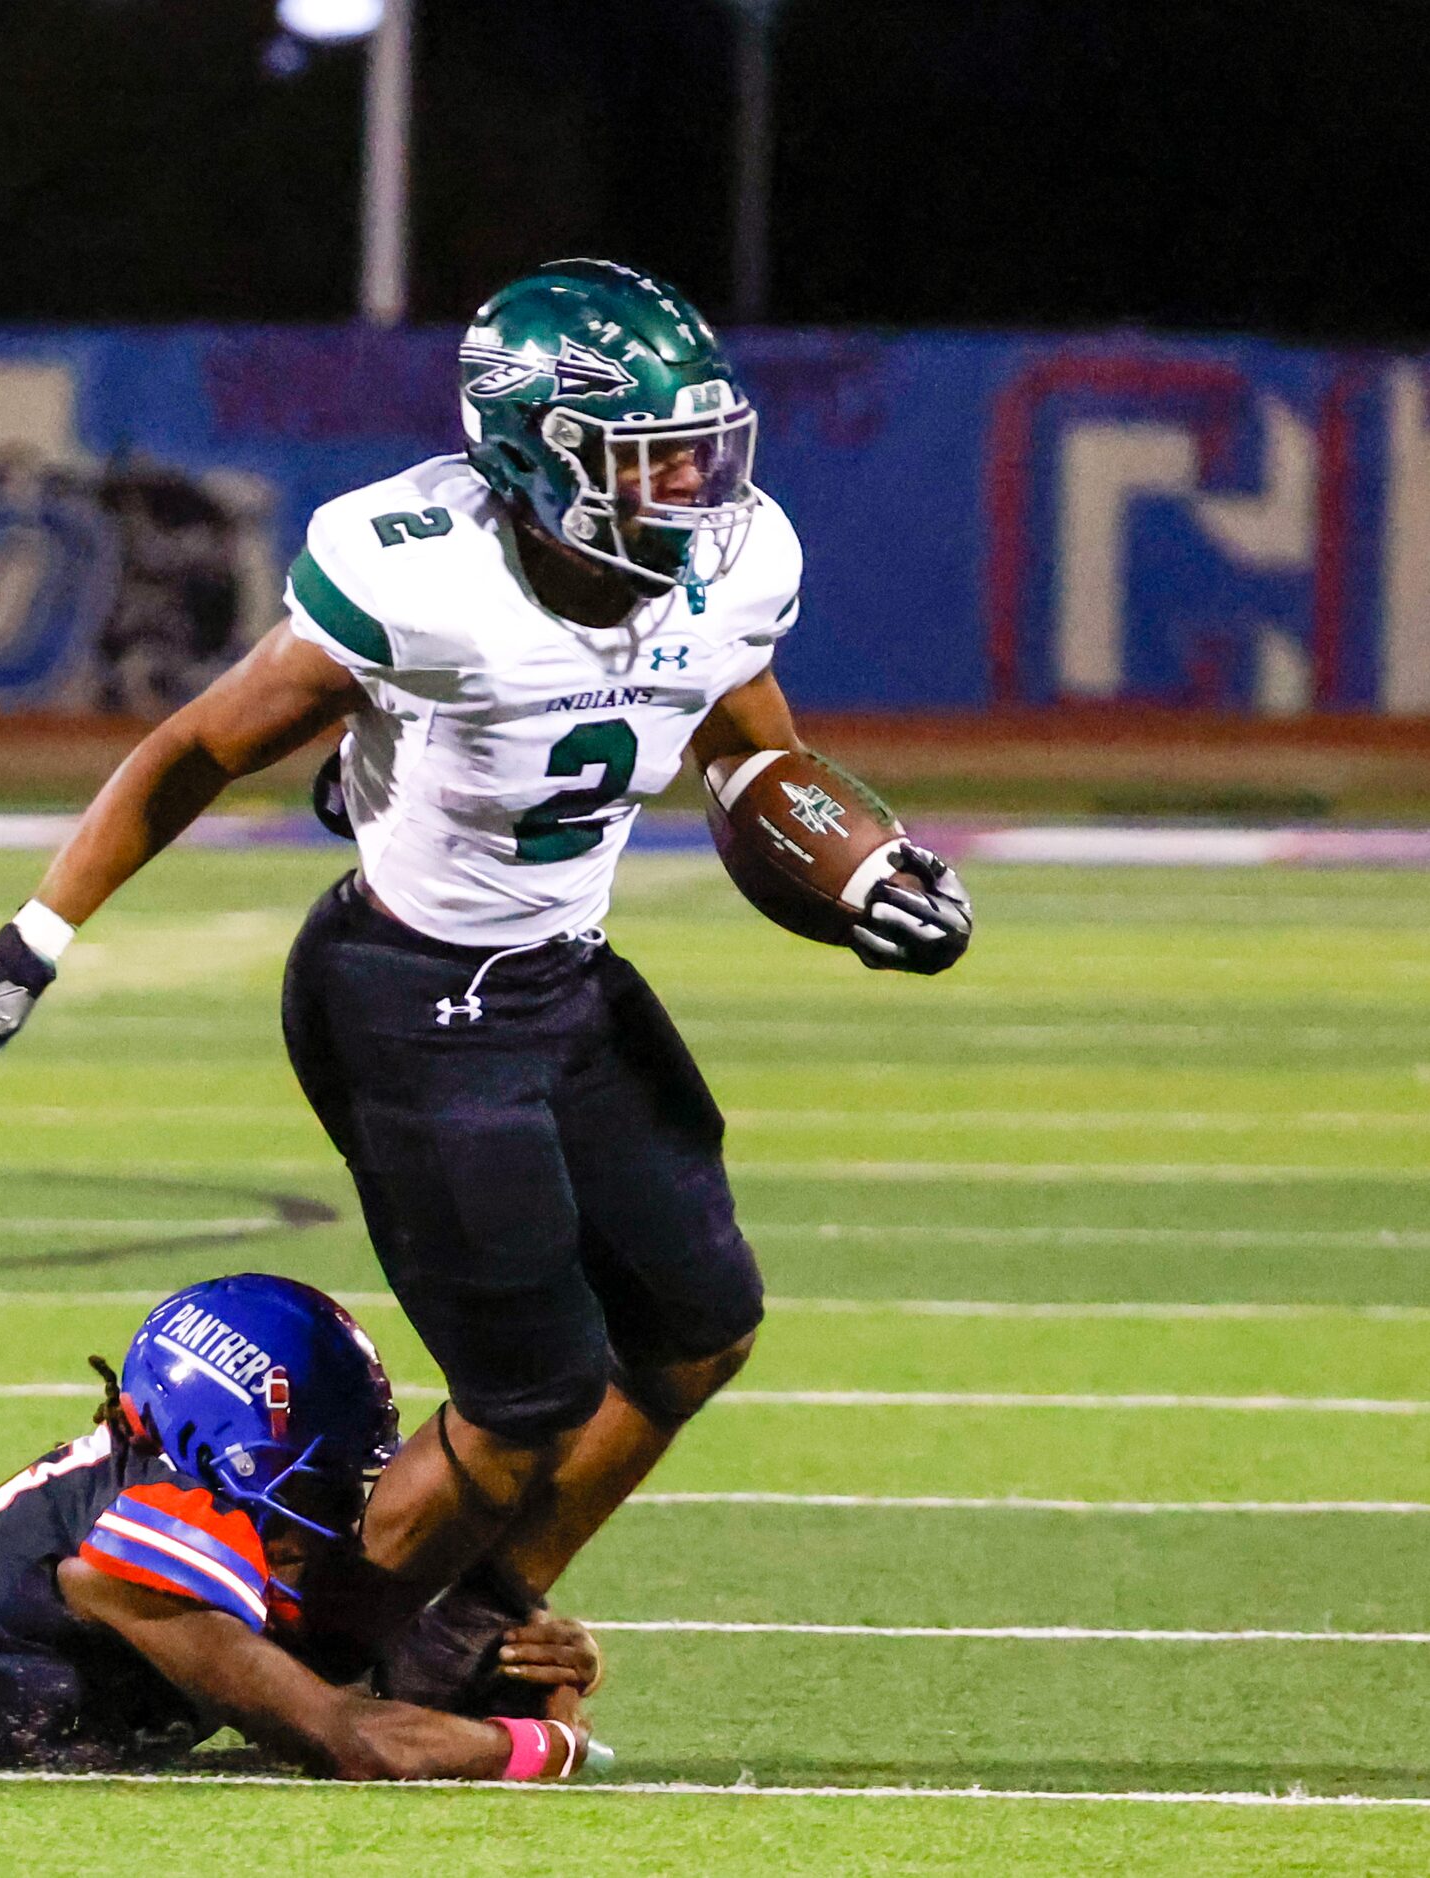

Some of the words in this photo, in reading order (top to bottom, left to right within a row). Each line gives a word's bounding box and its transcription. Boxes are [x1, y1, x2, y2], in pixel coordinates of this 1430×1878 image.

[370, 506, 454, 548] 2
[546, 686, 653, 713] INDIANS
[513, 717, 638, 866] 2
[161, 1302, 282, 1395] PANTHERS
